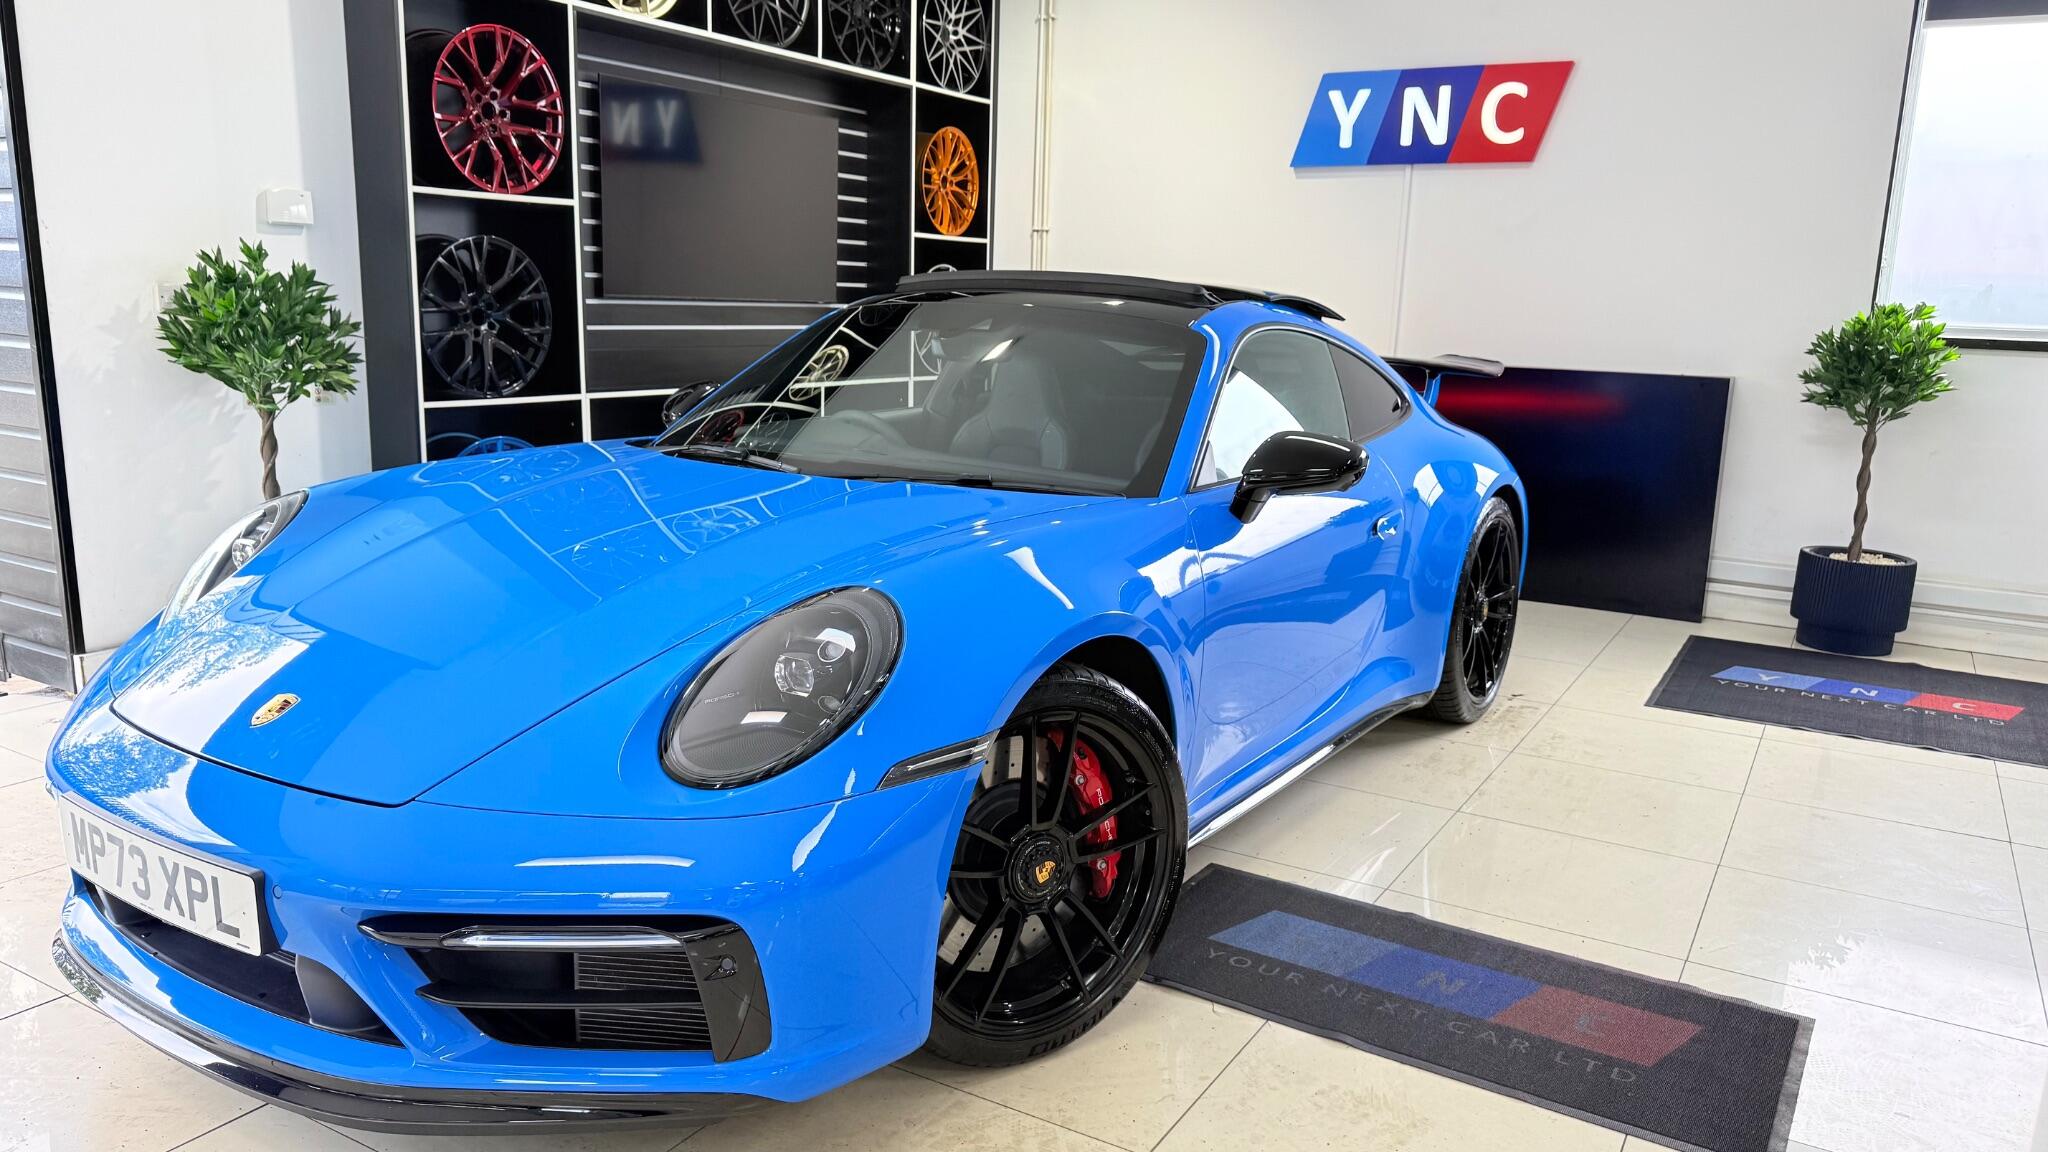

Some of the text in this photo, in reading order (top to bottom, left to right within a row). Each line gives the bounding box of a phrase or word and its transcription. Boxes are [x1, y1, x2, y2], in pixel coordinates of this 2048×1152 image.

[1328, 81, 1528, 148] YNC
[1718, 680, 2004, 726] YOUR NEXT CAR LTD
[70, 812, 241, 939] MP73 XPL
[1207, 948, 1636, 1082] YOUR NEXT CAR LTD
